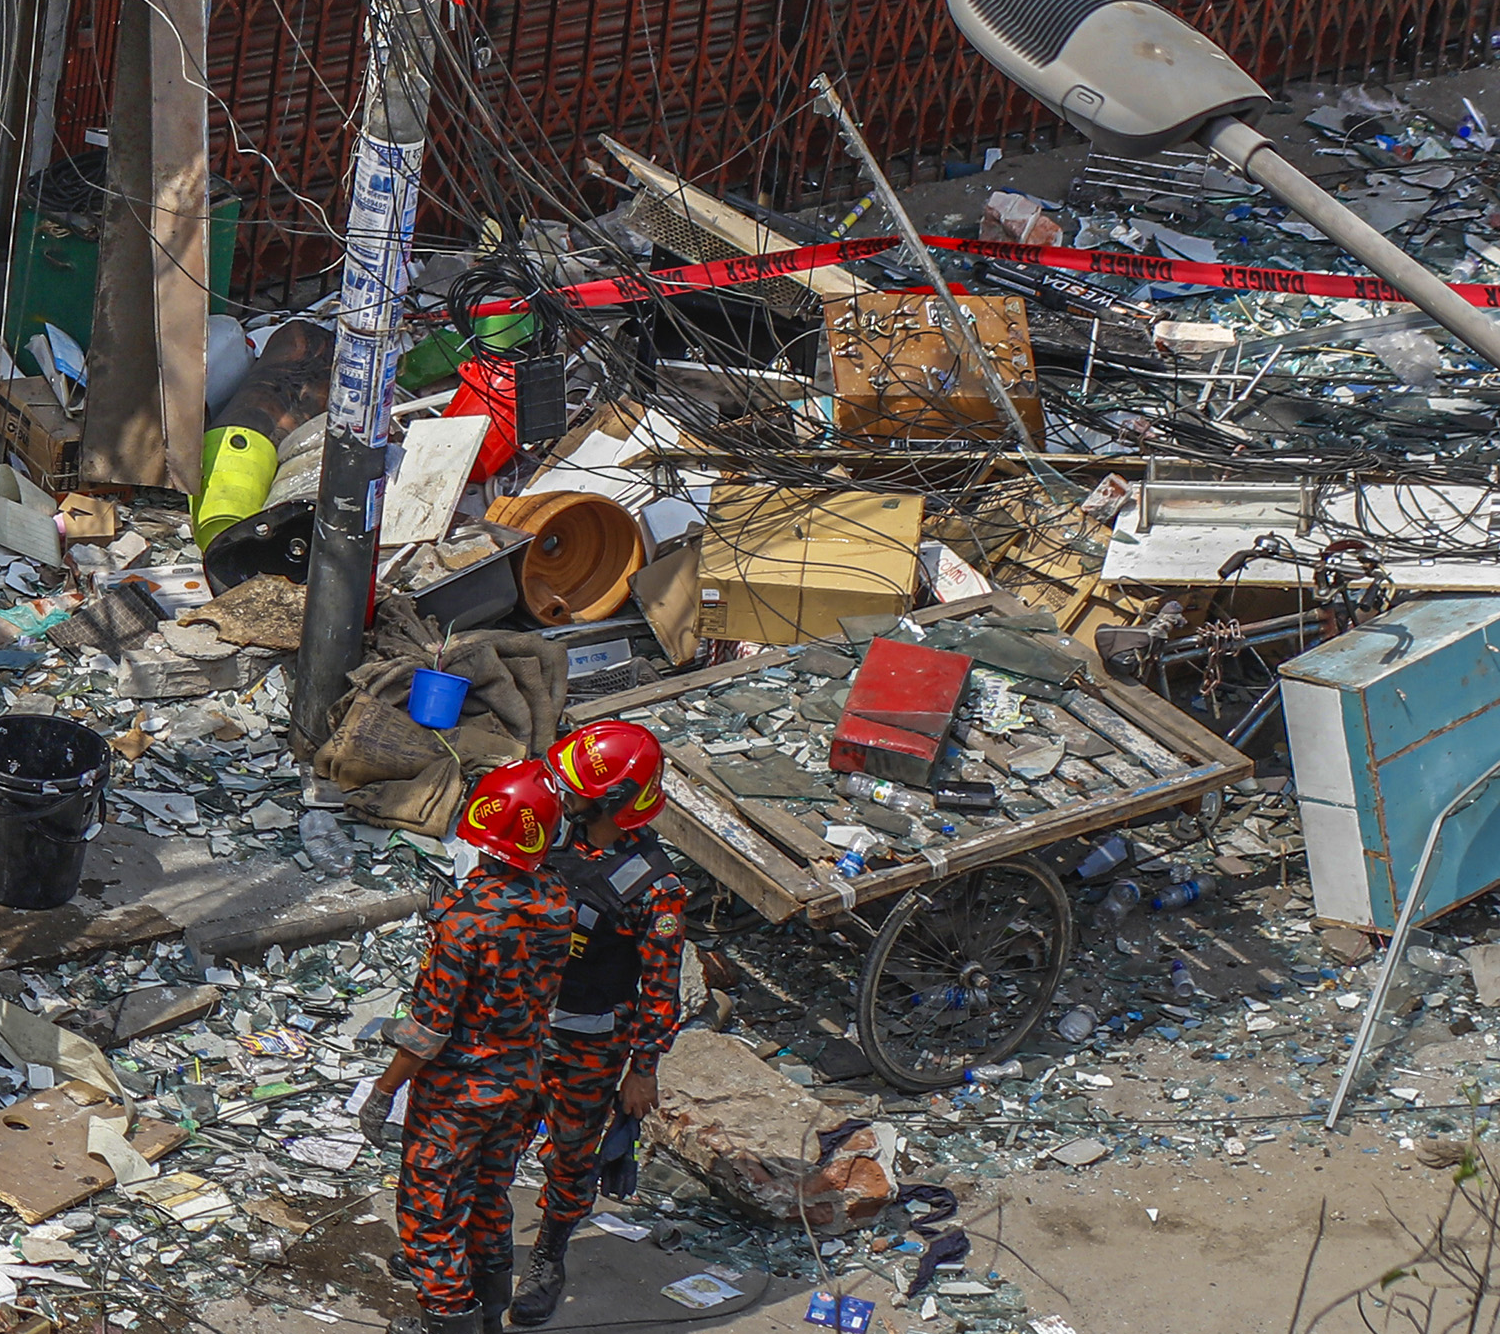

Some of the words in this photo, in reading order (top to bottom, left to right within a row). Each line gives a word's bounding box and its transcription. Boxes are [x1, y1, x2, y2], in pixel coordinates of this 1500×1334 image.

[725, 249, 800, 283] DANGER
[957, 238, 1041, 265] DANGER
[1090, 253, 1174, 282] DANGER
[1221, 267, 1306, 294] DANGER
[583, 733, 608, 777] RESCUE
[474, 799, 503, 822] FIRE
[519, 807, 539, 847] RESCUE
